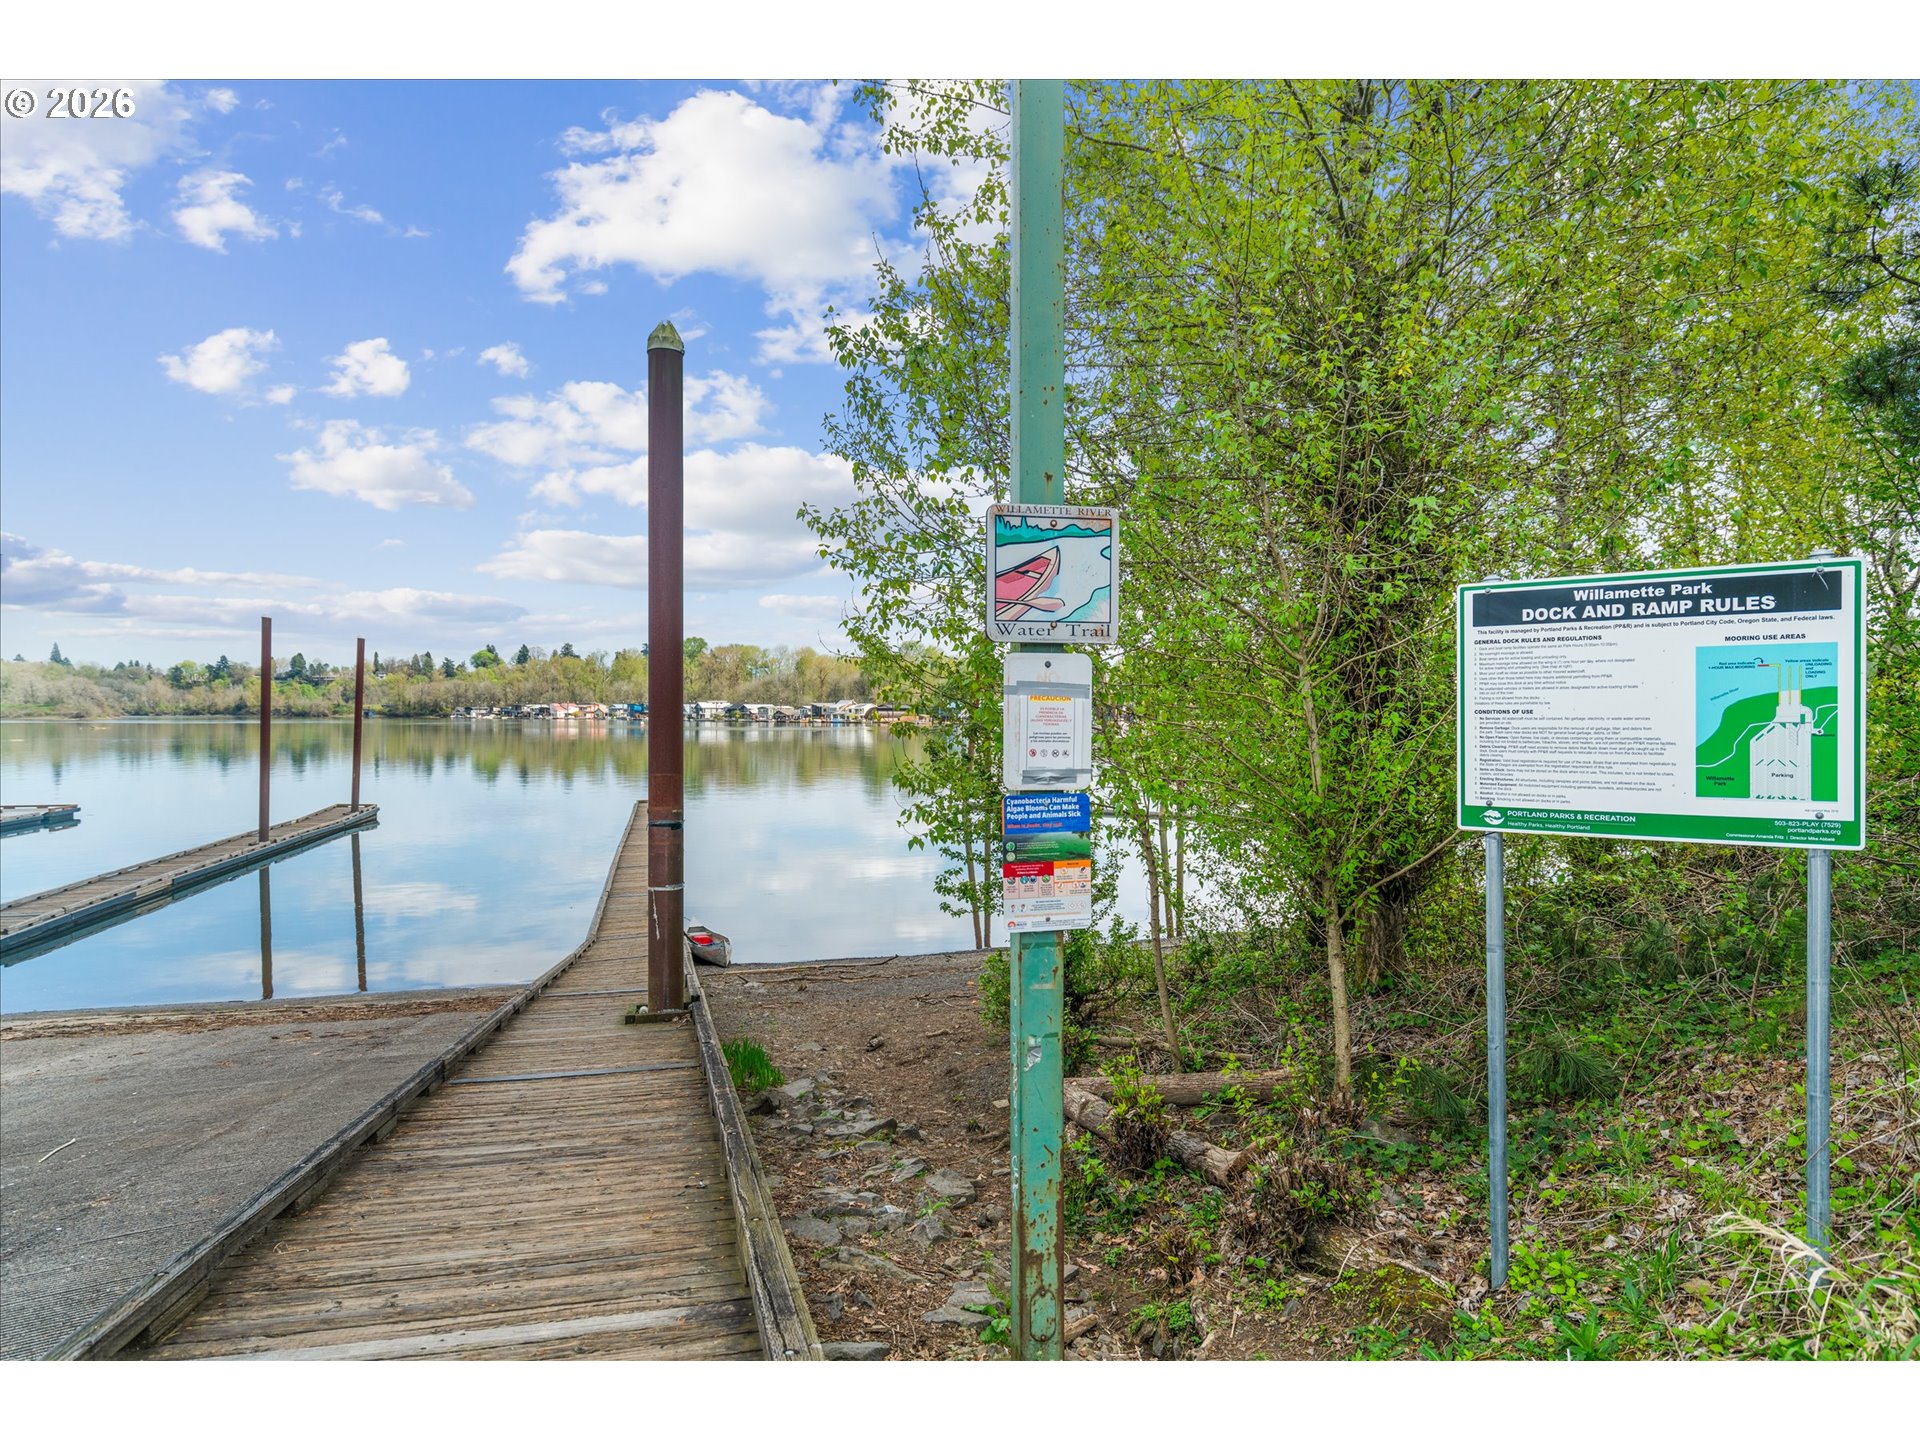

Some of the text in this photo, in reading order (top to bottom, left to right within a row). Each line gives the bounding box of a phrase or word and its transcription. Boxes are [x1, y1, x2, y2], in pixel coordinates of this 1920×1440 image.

[997, 505, 1111, 516] WILLAMETTE RIVER
[1574, 582, 1713, 601] Willamette Park
[1522, 595, 1776, 621] DOCK AND RAMP RULES
[996, 623, 1110, 637] Water Trail
[1584, 814, 1636, 822] RECREATION
[1787, 827, 1841, 835] portlandparks.org
